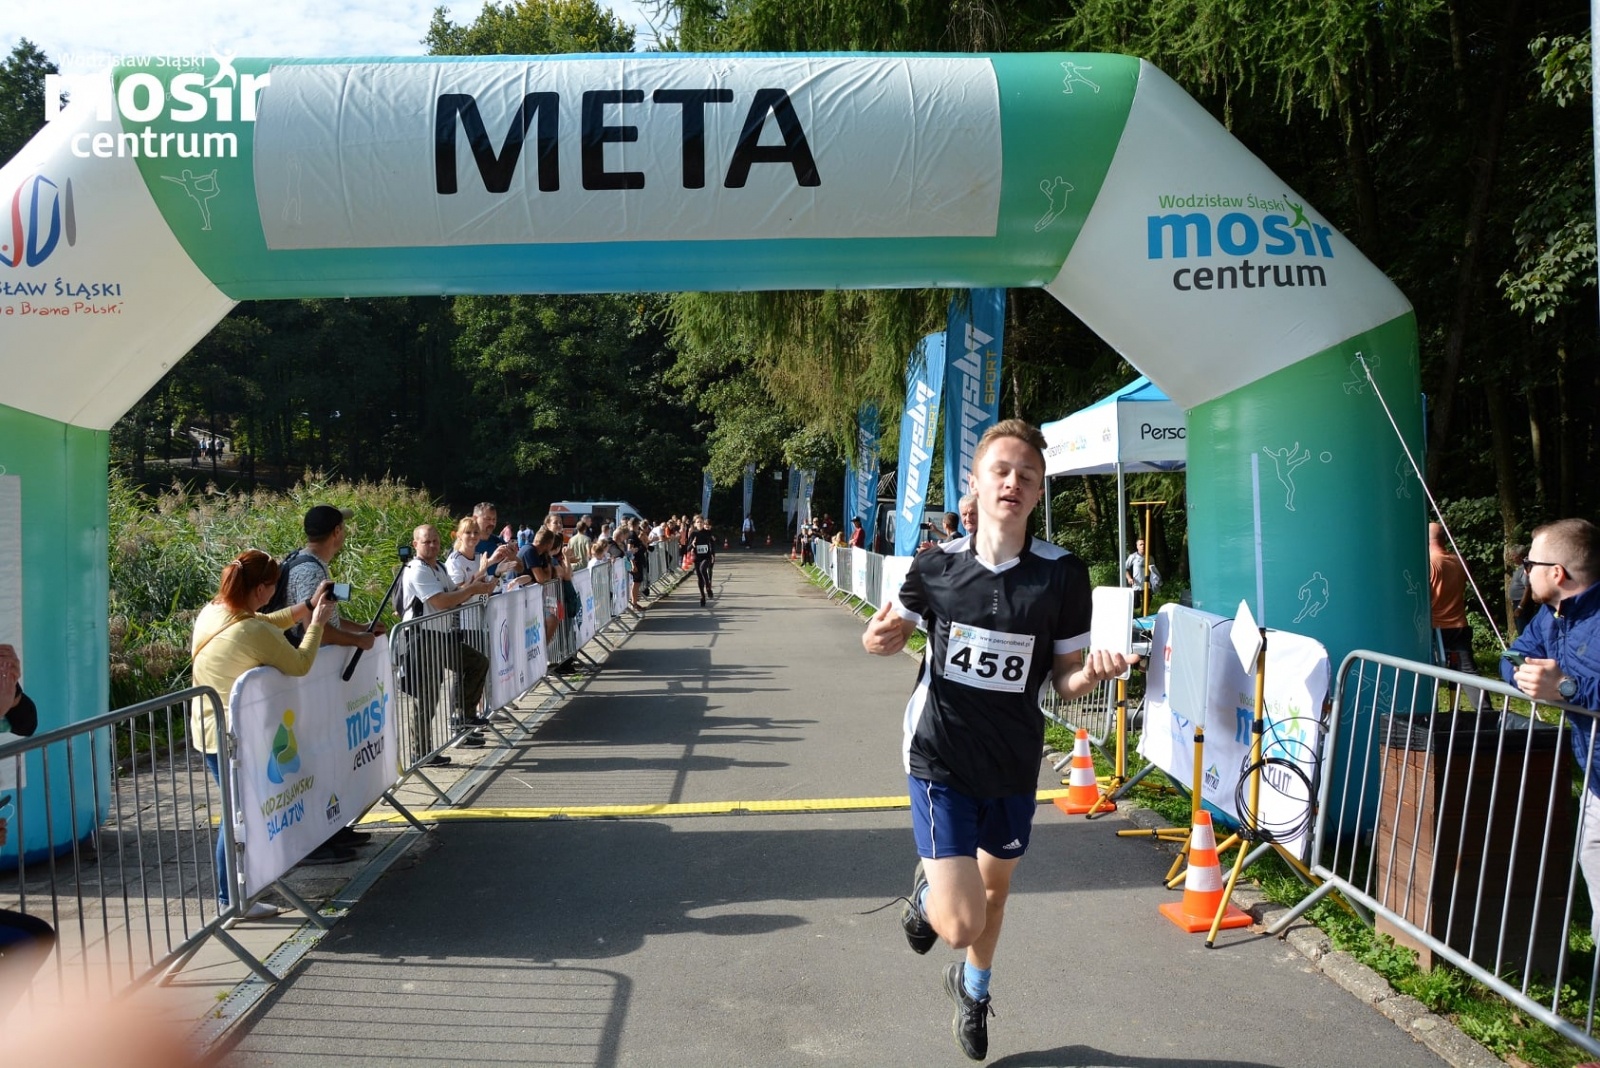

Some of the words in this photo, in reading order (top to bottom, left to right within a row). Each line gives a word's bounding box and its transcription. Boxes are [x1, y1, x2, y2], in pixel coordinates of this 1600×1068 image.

[435, 88, 821, 195] META
[1158, 194, 1243, 209] Wodzisław
[1247, 193, 1286, 212] Śląski
[1147, 212, 1335, 260] mosir
[0, 281, 47, 296] ŁAW
[54, 277, 121, 300] ŚLĄSKI
[1173, 259, 1327, 291] centrum
[21, 301, 69, 316] Brama
[74, 301, 124, 315] Polski
[984, 349, 998, 405] SPORT
[926, 403, 938, 448] SPORT
[950, 645, 1025, 682] 458
